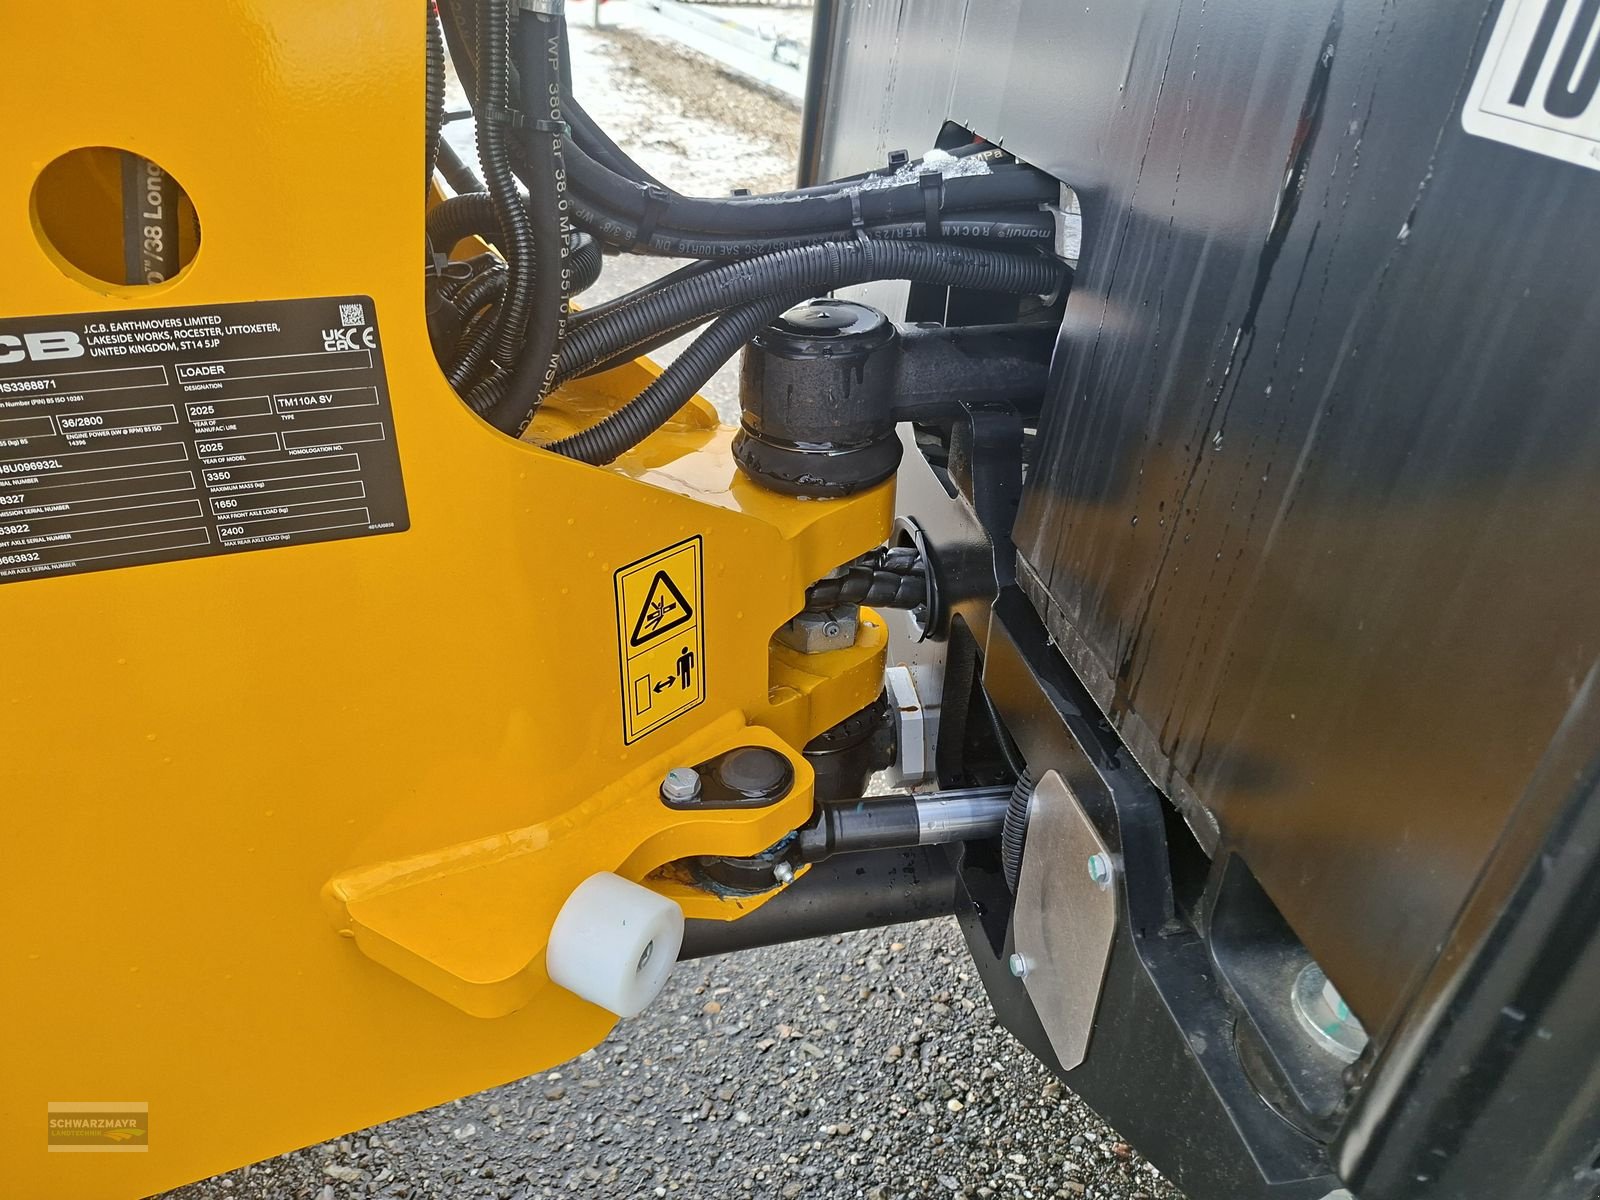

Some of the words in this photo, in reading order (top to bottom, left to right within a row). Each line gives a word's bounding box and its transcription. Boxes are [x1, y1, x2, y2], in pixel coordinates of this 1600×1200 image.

[548, 35, 559, 71] WP
[549, 83, 561, 120] 380
[555, 169, 568, 211] 38.0
[560, 216, 571, 259] MPa
[719, 245, 740, 256] SAE
[559, 268, 571, 314] 5510
[83, 324, 109, 334] J.C.B.
[110, 318, 182, 332] EARTHMOVERS
[183, 315, 222, 327] LIMITED
[86, 333, 133, 346] LAKESIDE
[134, 330, 173, 342] WORKS,
[174, 327, 224, 339] ROCESTER,
[224, 322, 281, 335] UTTOXETER,
[90, 345, 127, 357] UNITED
[128, 342, 180, 354] KINGDOM,
[181, 340, 203, 350] ST14
[204, 338, 220, 349] 5JP
[180, 365, 226, 377] LOADER
[184, 383, 223, 392] DESIGNATION
[5, 400, 30, 408] Number
[277, 396, 318, 408] TM110A
[318, 394, 333, 404] SV
[190, 406, 215, 416] 2025
[62, 416, 103, 429] 36/2800
[66, 432, 89, 440] ENGINE
[89, 430, 111, 438] POWER
[200, 442, 224, 453] 2025
[288, 446, 333, 456] HOMOLOGATION
[12, 477, 39, 486] NUMBER
[206, 471, 231, 482] 3350
[210, 485, 239, 493] MAXIMUM
[24, 506, 44, 515] SERIAL
[44, 504, 71, 512] NUMBER
[214, 499, 238, 509] 1650
[217, 513, 230, 521] MAX
[230, 511, 249, 519] FRONT
[221, 526, 244, 537] 2400
[11, 539, 26, 547] AXLE
[46, 533, 72, 542] NUMBER
[17, 567, 31, 575] AXLE
[52, 561, 77, 569] NUMBER
